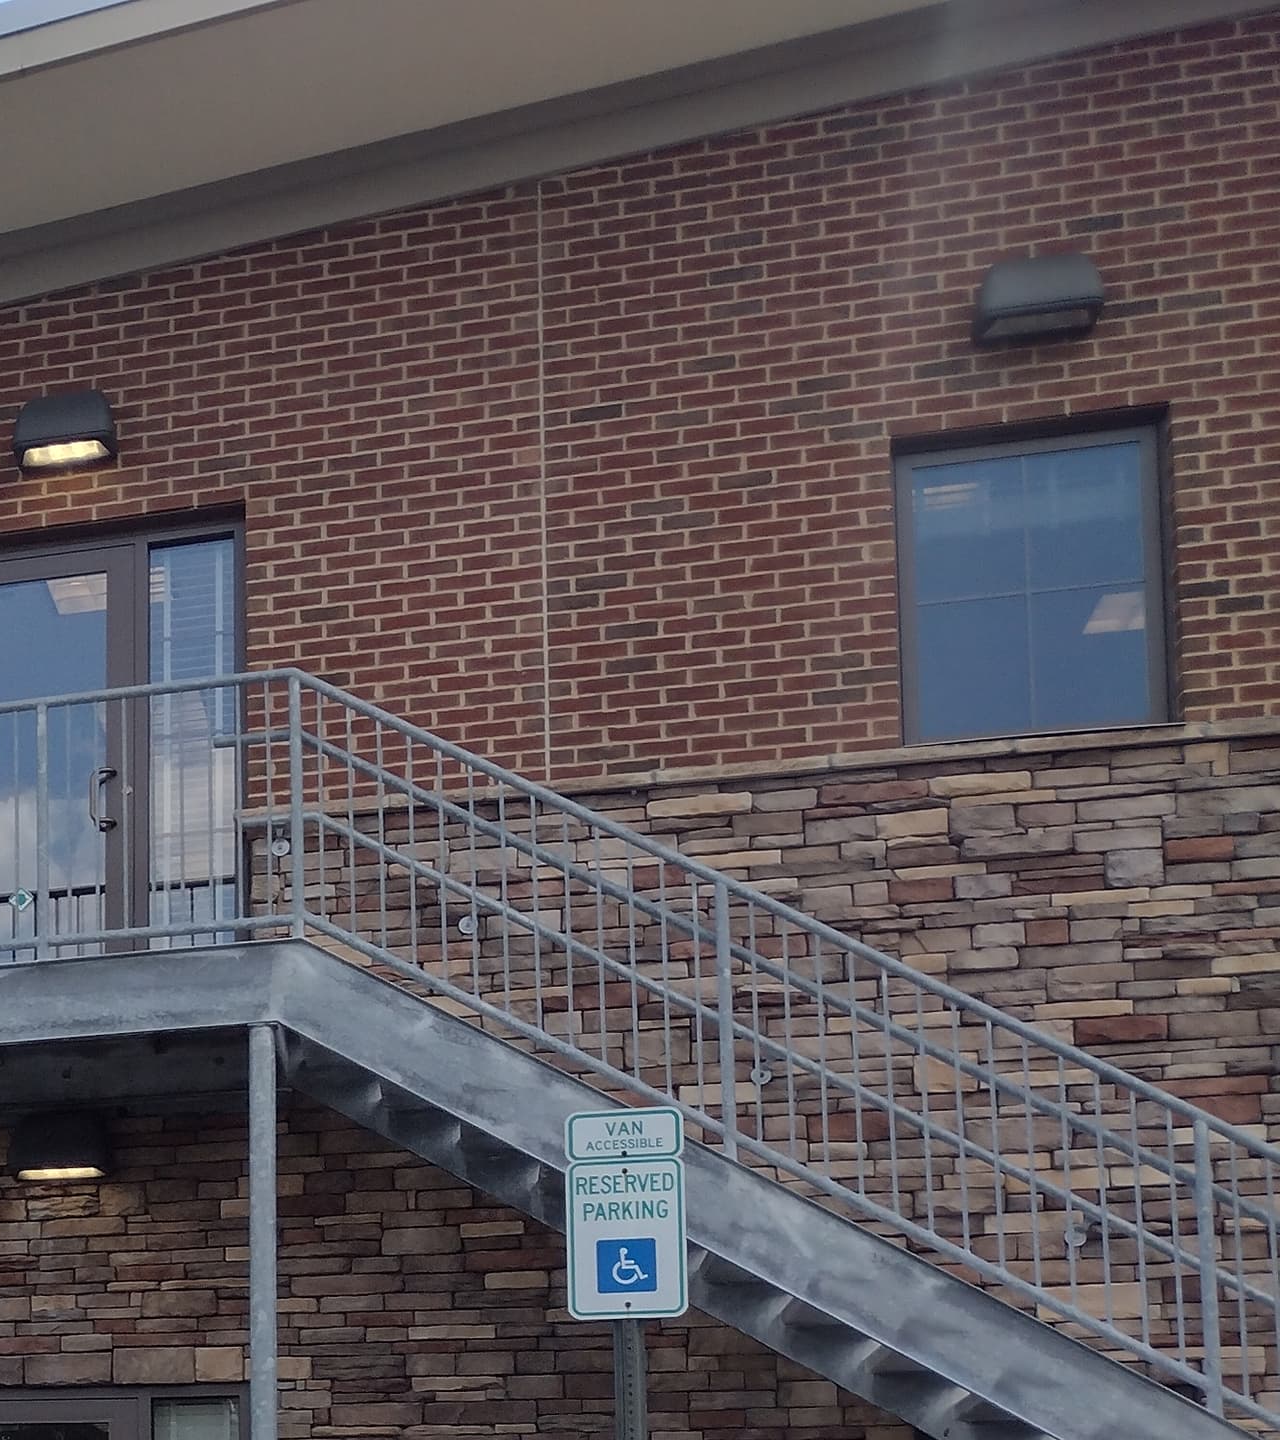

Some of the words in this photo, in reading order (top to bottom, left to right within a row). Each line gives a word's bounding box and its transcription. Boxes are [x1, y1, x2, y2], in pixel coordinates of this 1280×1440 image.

[605, 1120, 643, 1136] VAN
[586, 1137, 664, 1151] ACCESSIBLE
[575, 1172, 674, 1196] RESERVED
[583, 1199, 668, 1222] PARKING
